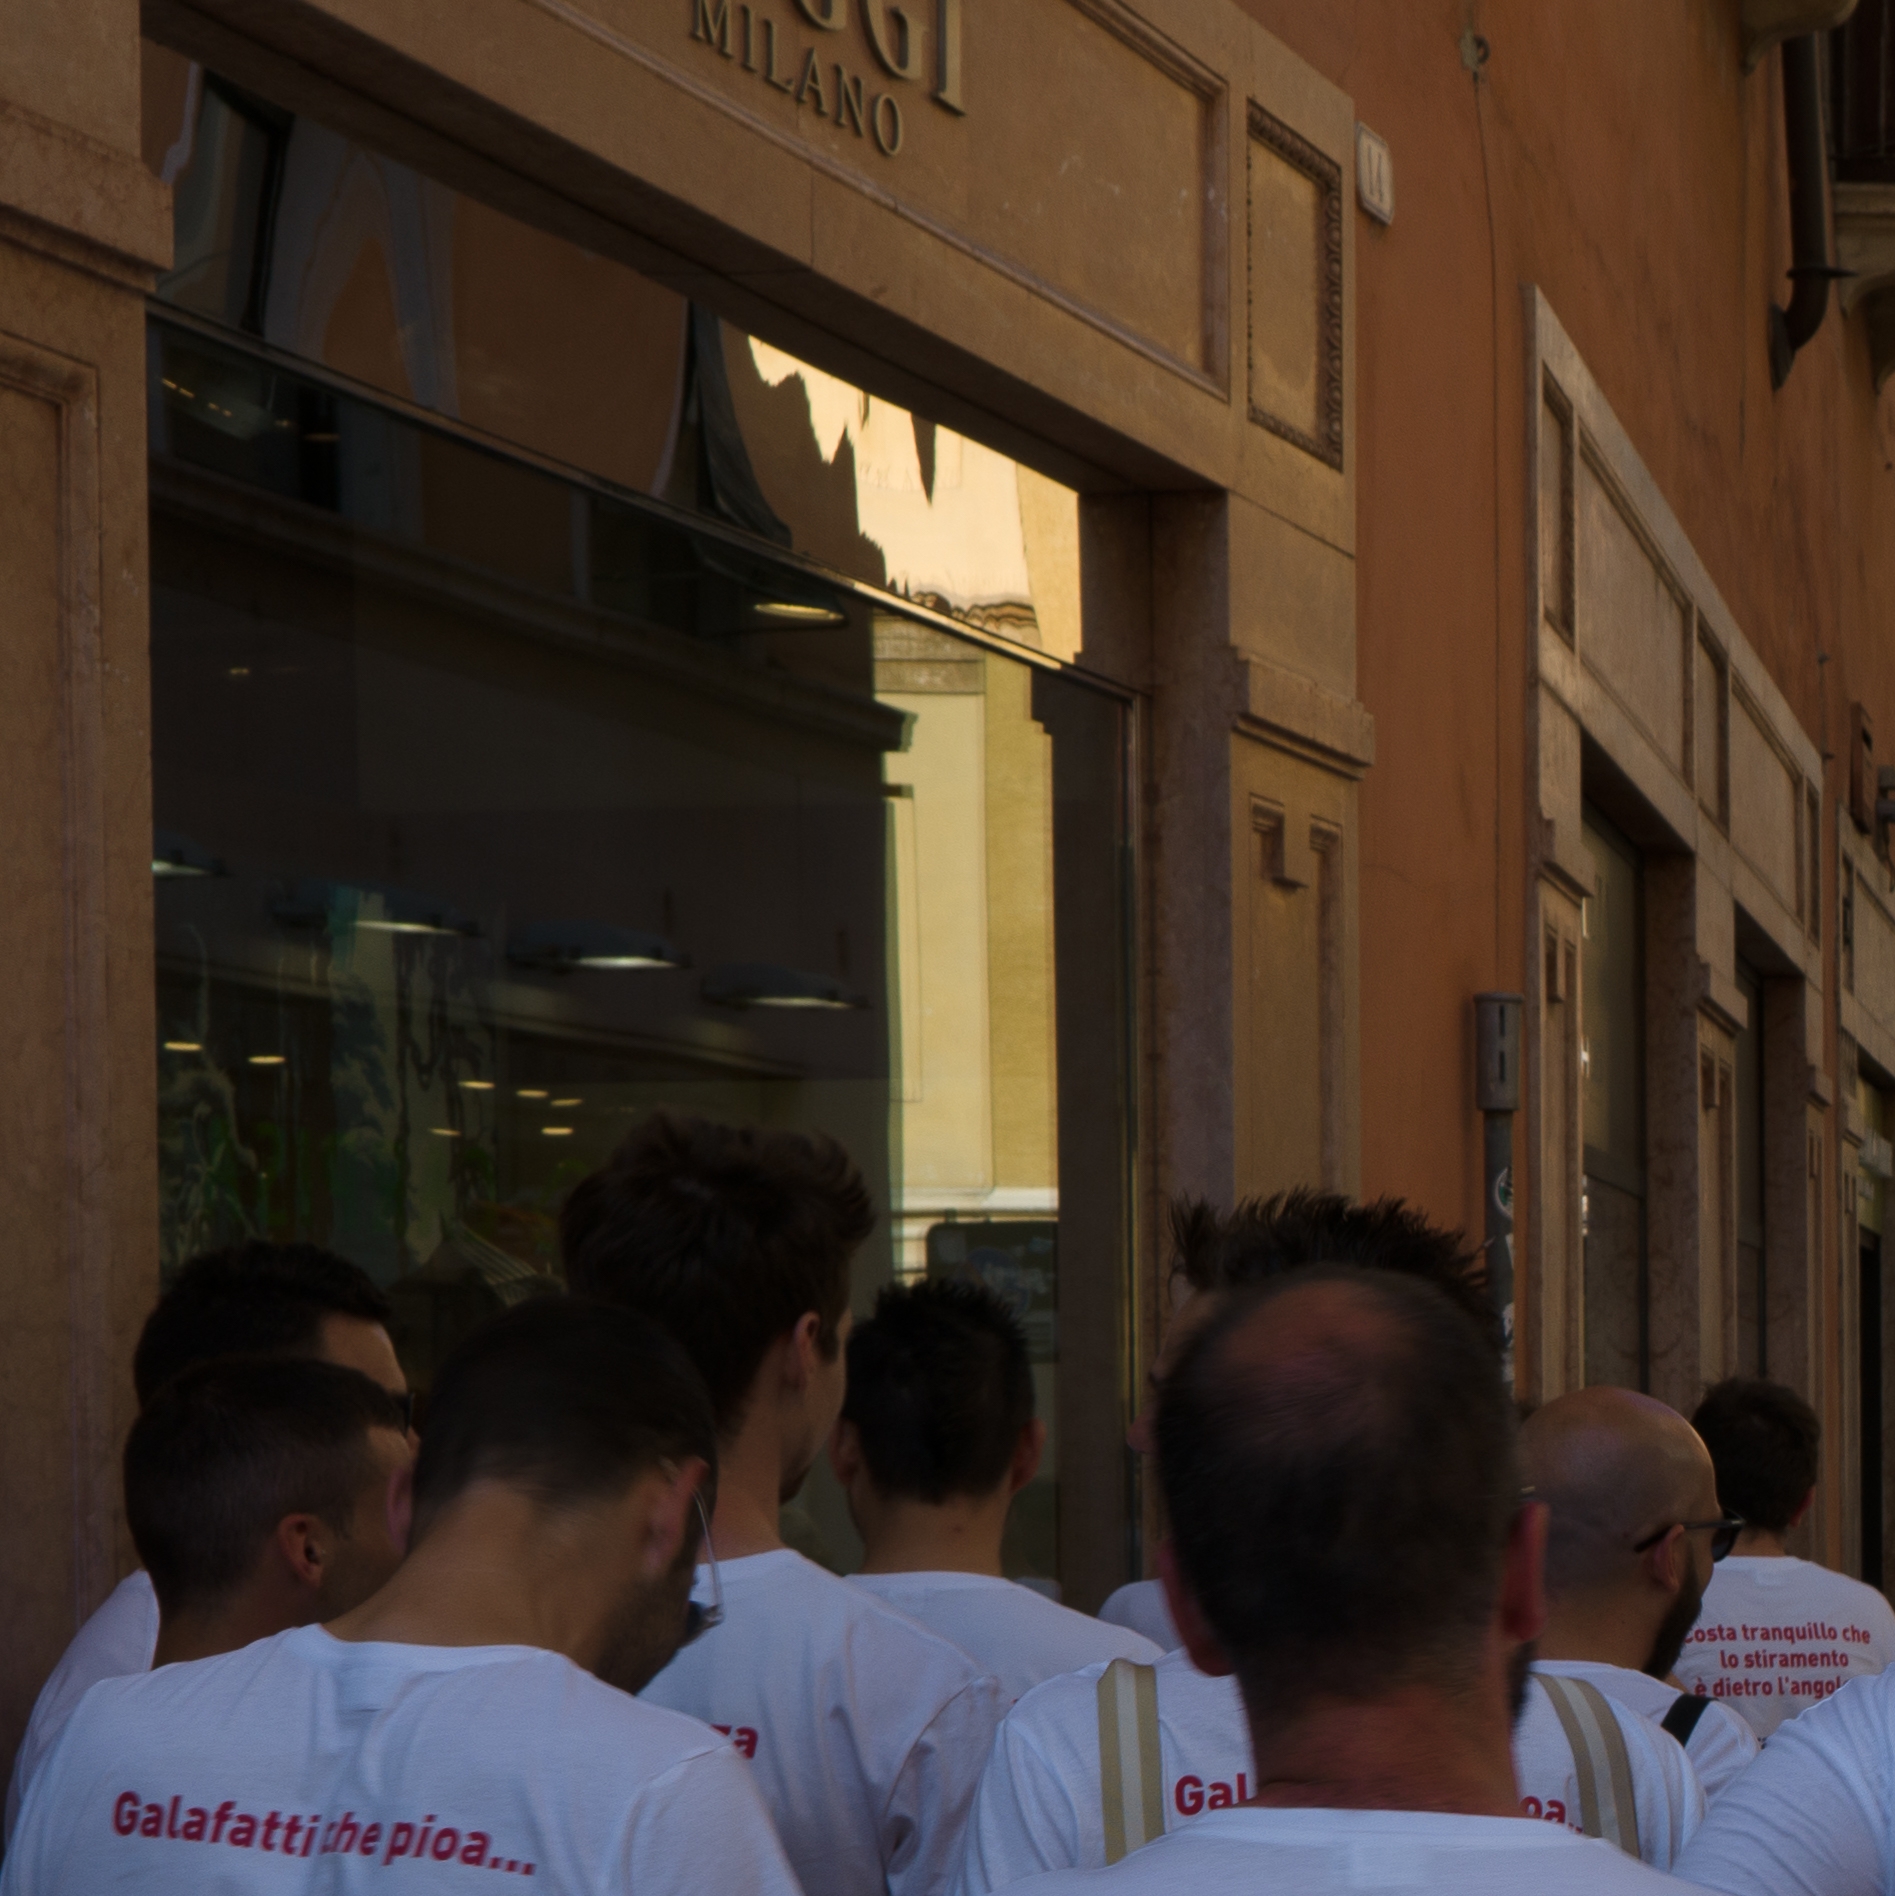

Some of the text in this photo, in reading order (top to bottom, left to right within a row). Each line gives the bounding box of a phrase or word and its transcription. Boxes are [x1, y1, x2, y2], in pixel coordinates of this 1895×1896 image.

[691, 0, 905, 158] MILANO
[1741, 1622, 1838, 1644] tranquillo
[1842, 1625, 1871, 1644] che
[1720, 1648, 1849, 1669] lo stiramento
[1694, 1677, 1707, 1697] è
[1712, 1677, 1773, 1697] dietro
[112, 1790, 322, 1858] Galafatti
[381, 1813, 537, 1876] pioa...
